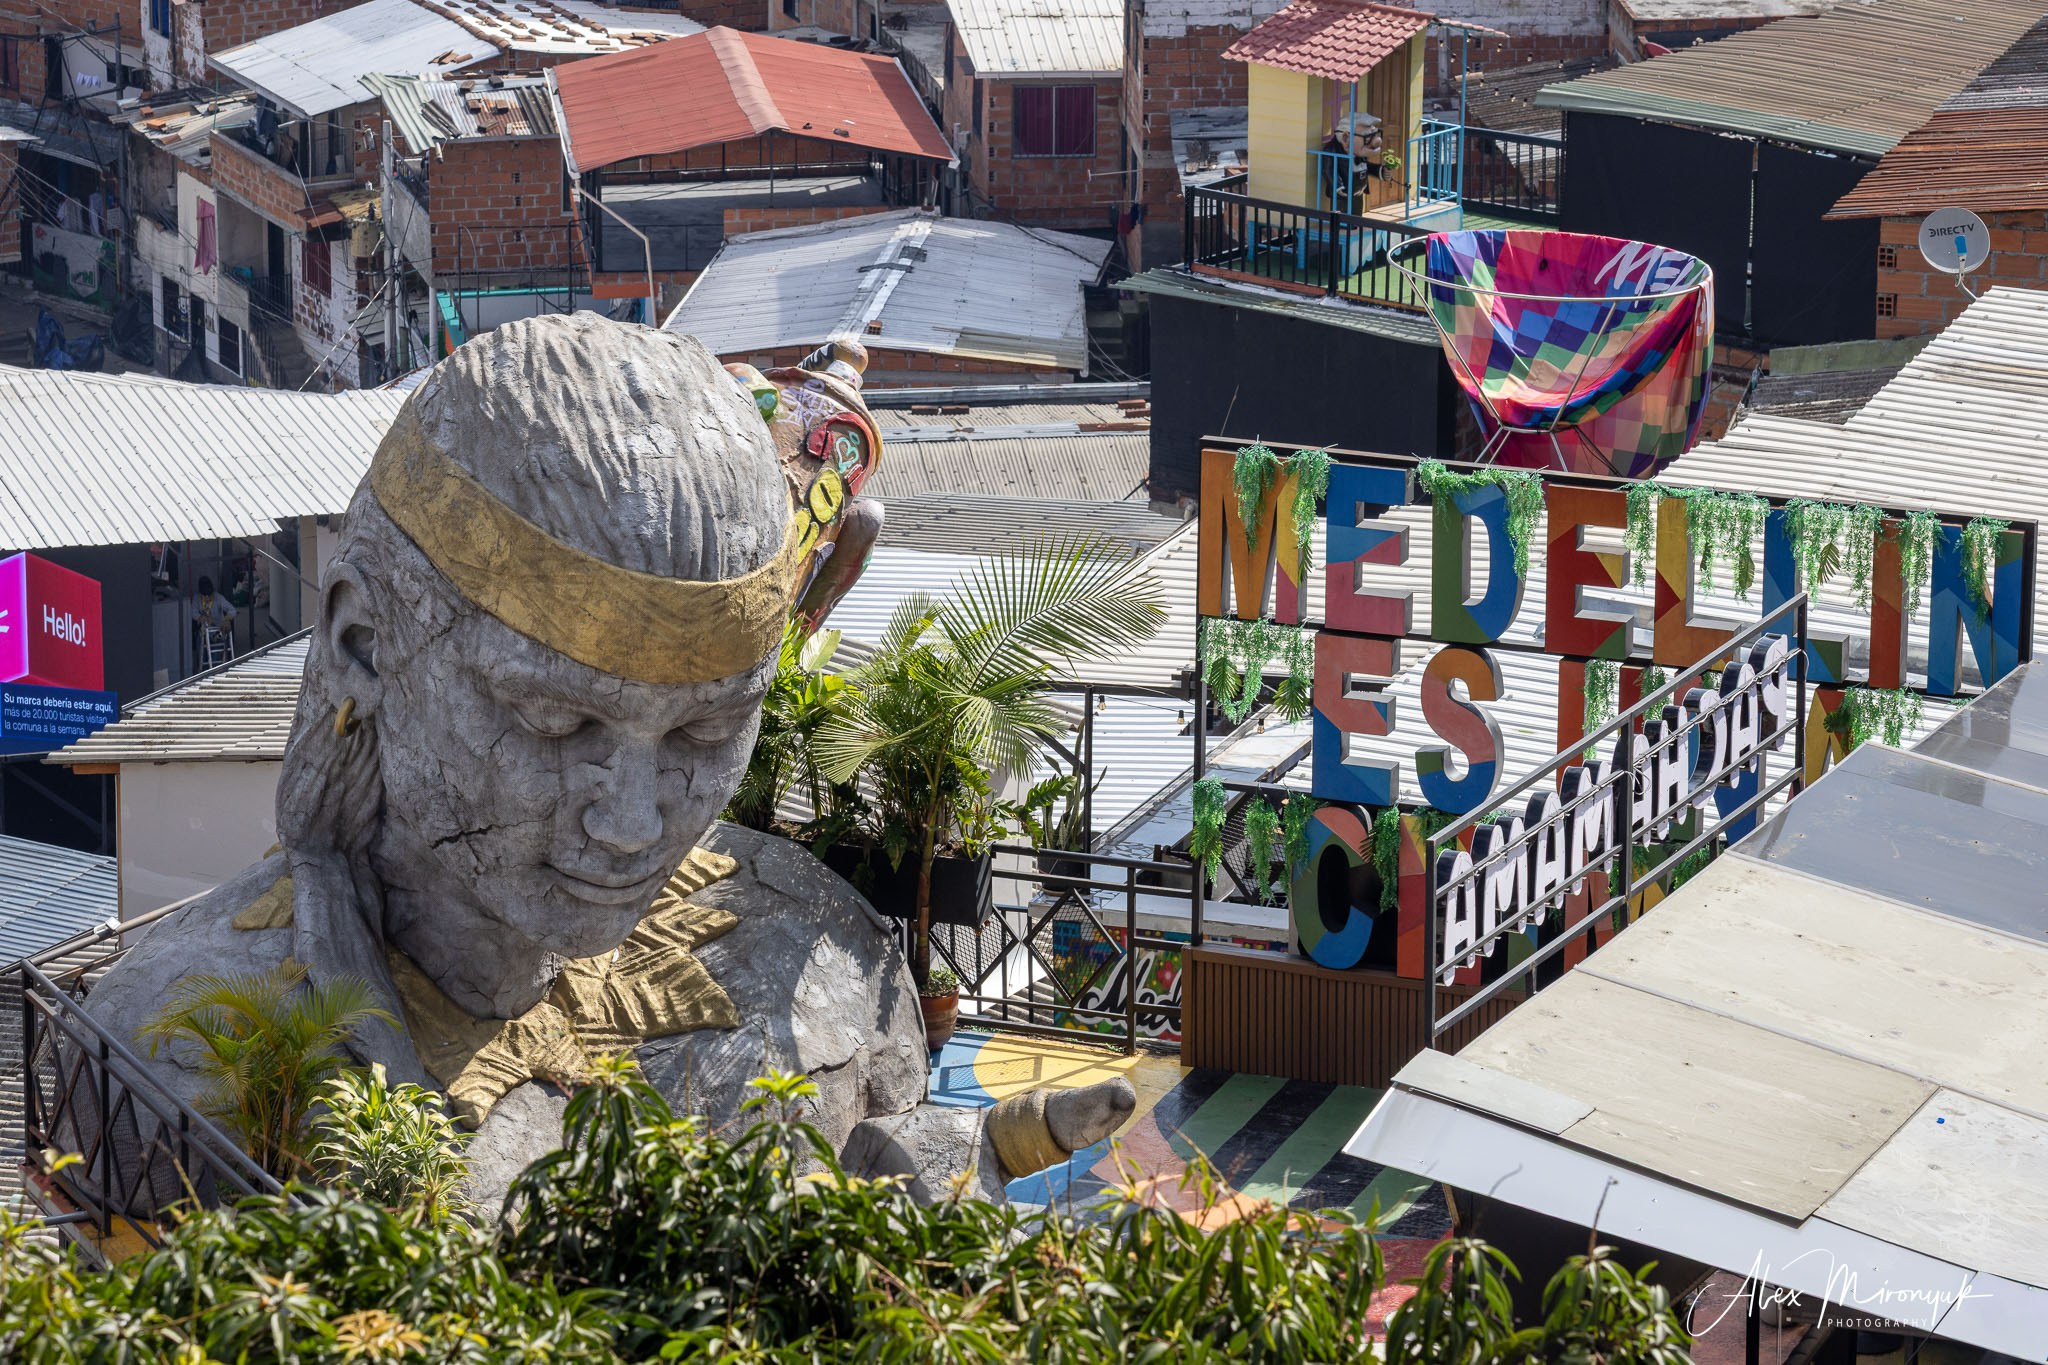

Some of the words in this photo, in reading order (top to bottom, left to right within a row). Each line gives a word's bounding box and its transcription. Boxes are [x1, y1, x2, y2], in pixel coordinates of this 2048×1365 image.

[1928, 224, 1975, 237] DIRECTV
[43, 603, 86, 647] Hello!
[4, 693, 15, 703] Su
[16, 696, 41, 705] marca
[73, 701, 93, 710] estar
[4, 707, 20, 717] más
[21, 709, 31, 718] de
[32, 709, 58, 720] 20.000
[59, 712, 85, 722] turistas
[86, 714, 108, 724] visitan
[4, 720, 11, 730] la
[12, 721, 42, 732] comuna
[43, 725, 48, 733] a
[49, 723, 56, 733] la
[57, 725, 87, 736] semana.
[1312, 634, 1505, 816] ES
